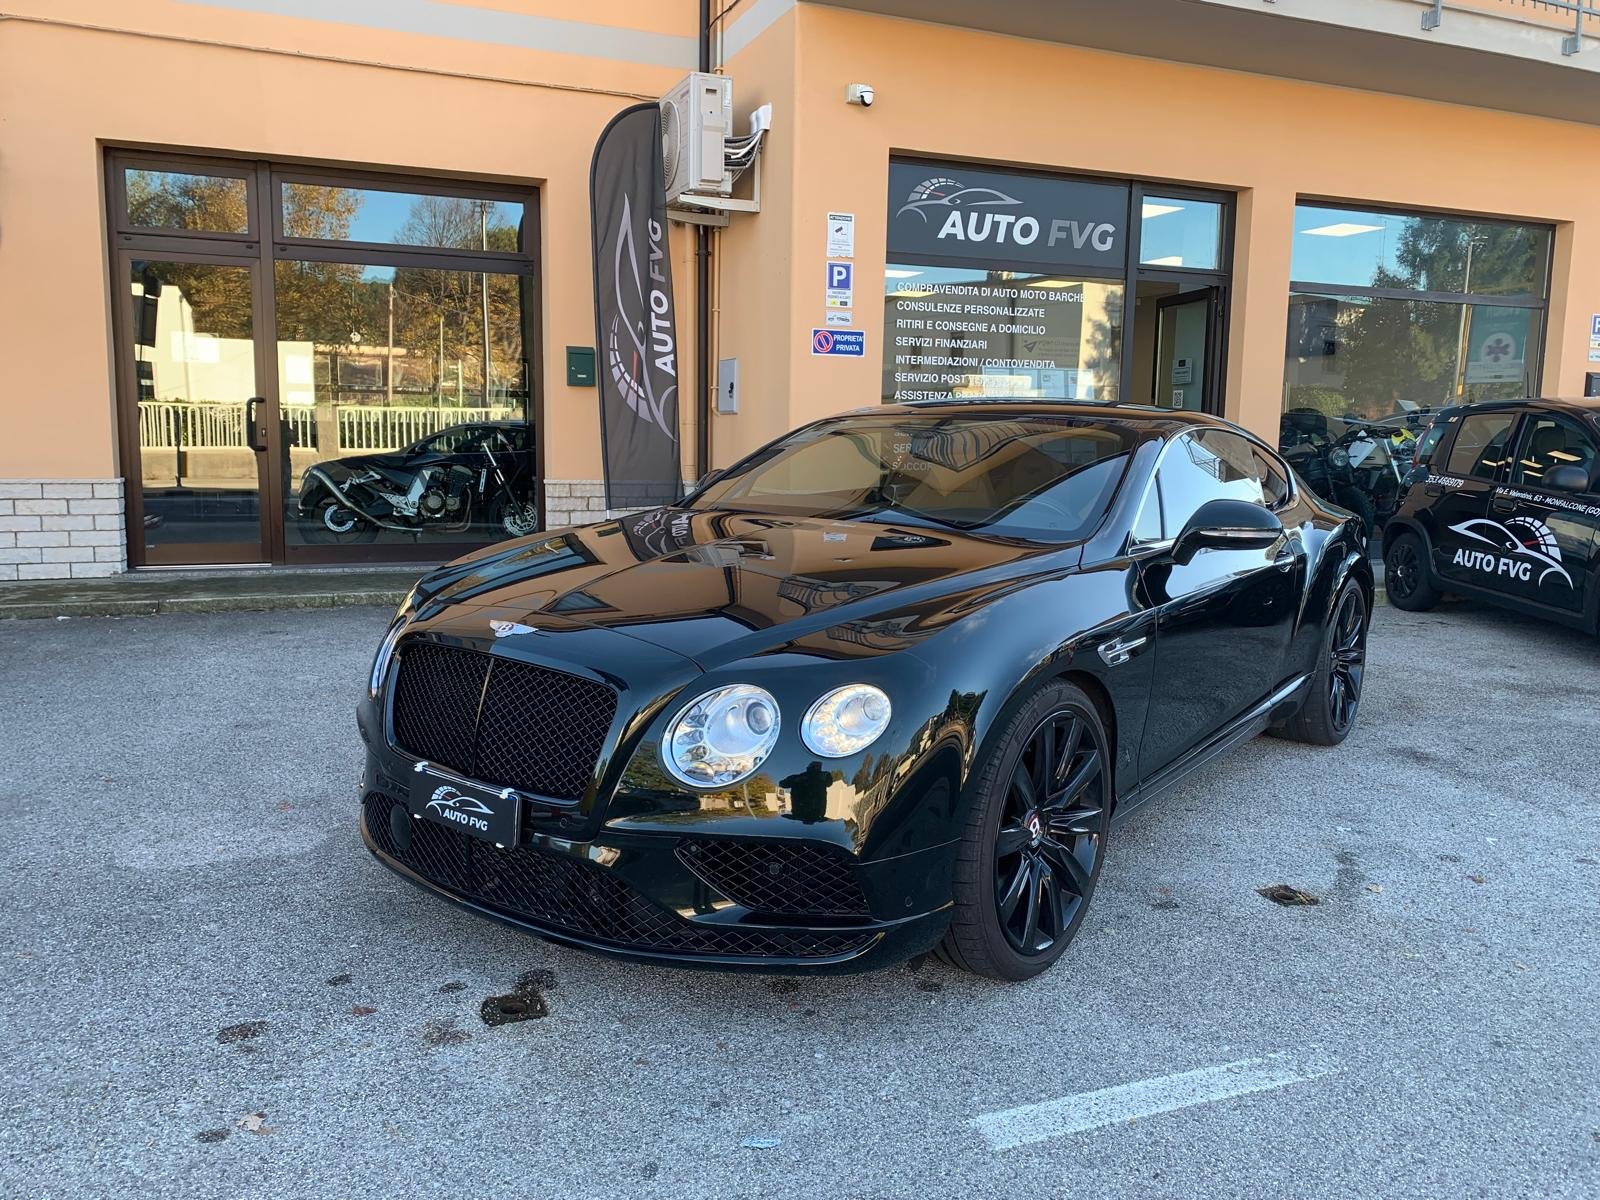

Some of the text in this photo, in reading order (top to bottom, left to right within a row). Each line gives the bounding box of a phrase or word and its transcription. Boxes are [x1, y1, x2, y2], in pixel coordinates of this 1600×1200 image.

[937, 210, 1116, 251] AUTO FVG
[833, 266, 847, 287] P
[648, 217, 676, 377] AUTO FVG
[897, 282, 1085, 303] COMPRAVENDITA DI AUTO MOTO BARCHE
[896, 301, 1045, 318] CONSULENZE PERSONALIZZATE
[896, 319, 1046, 335] RITIRI E CONSEGNE A DOMICILIO
[895, 337, 987, 349] SERVIZI FINANZIARI
[895, 355, 978, 367] INTERMEDIAZIONI
[985, 358, 1056, 369] CONTOVENDITA
[894, 373, 938, 383] SERVIZIO
[941, 374, 965, 383] POST
[894, 390, 953, 400] ASSISTENZA
[1545, 496, 1588, 512] MONFALCONE
[1452, 548, 1532, 581] AUTO FVG
[443, 808, 488, 831] AUTO FVG
